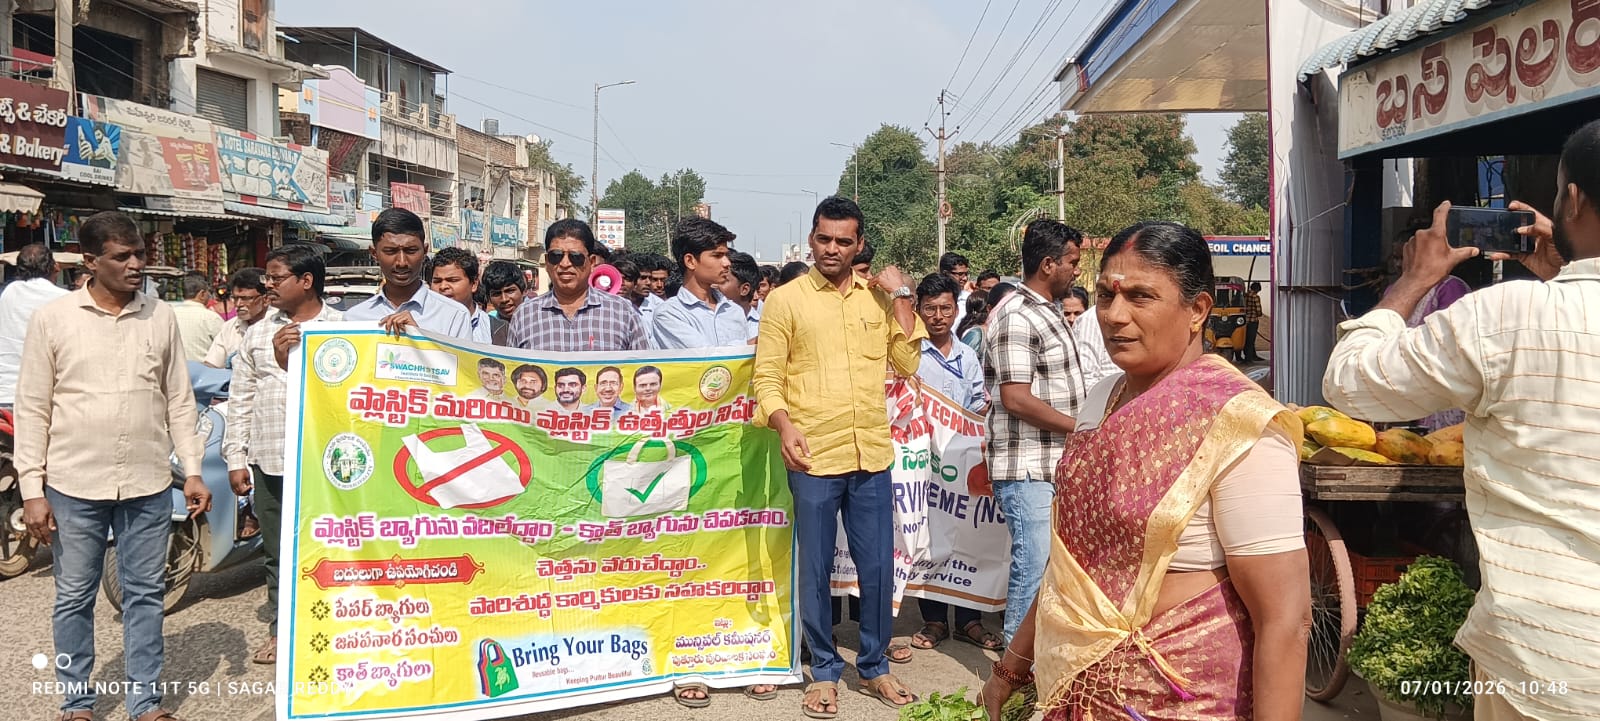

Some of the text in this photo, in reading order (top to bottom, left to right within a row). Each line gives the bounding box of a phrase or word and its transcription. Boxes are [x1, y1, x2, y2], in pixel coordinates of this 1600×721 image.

[17, 102, 31, 121] &
[0, 133, 64, 165] & Bakery
[223, 135, 243, 152] HOTEL
[350, 386, 429, 424] ప్లాస్టిక్
[434, 394, 530, 424] మరియు
[537, 409, 611, 441] ప్లాస్టిక్
[617, 409, 713, 438] ఉత్పత్తుల
[314, 515, 374, 547] ప్లాస్టిక్
[380, 516, 458, 545] బ్యాగును
[579, 520, 623, 542] క్లాత్
[627, 515, 699, 539] బ్యాగును
[333, 567, 382, 581] బదులుగా
[537, 557, 596, 581] చెత్తను
[952, 560, 977, 573] the
[556, 584, 660, 610] కార్మికులకు
[664, 580, 774, 600] సహకరిద్దాం
[335, 596, 430, 623] పేపర్ బ్యాగులు
[335, 626, 458, 649] జనపనార సంచులు
[512, 634, 648, 667] Bring Your Bags
[371, 660, 431, 687] బ్యాగులు
[565, 676, 589, 685] Keeping
